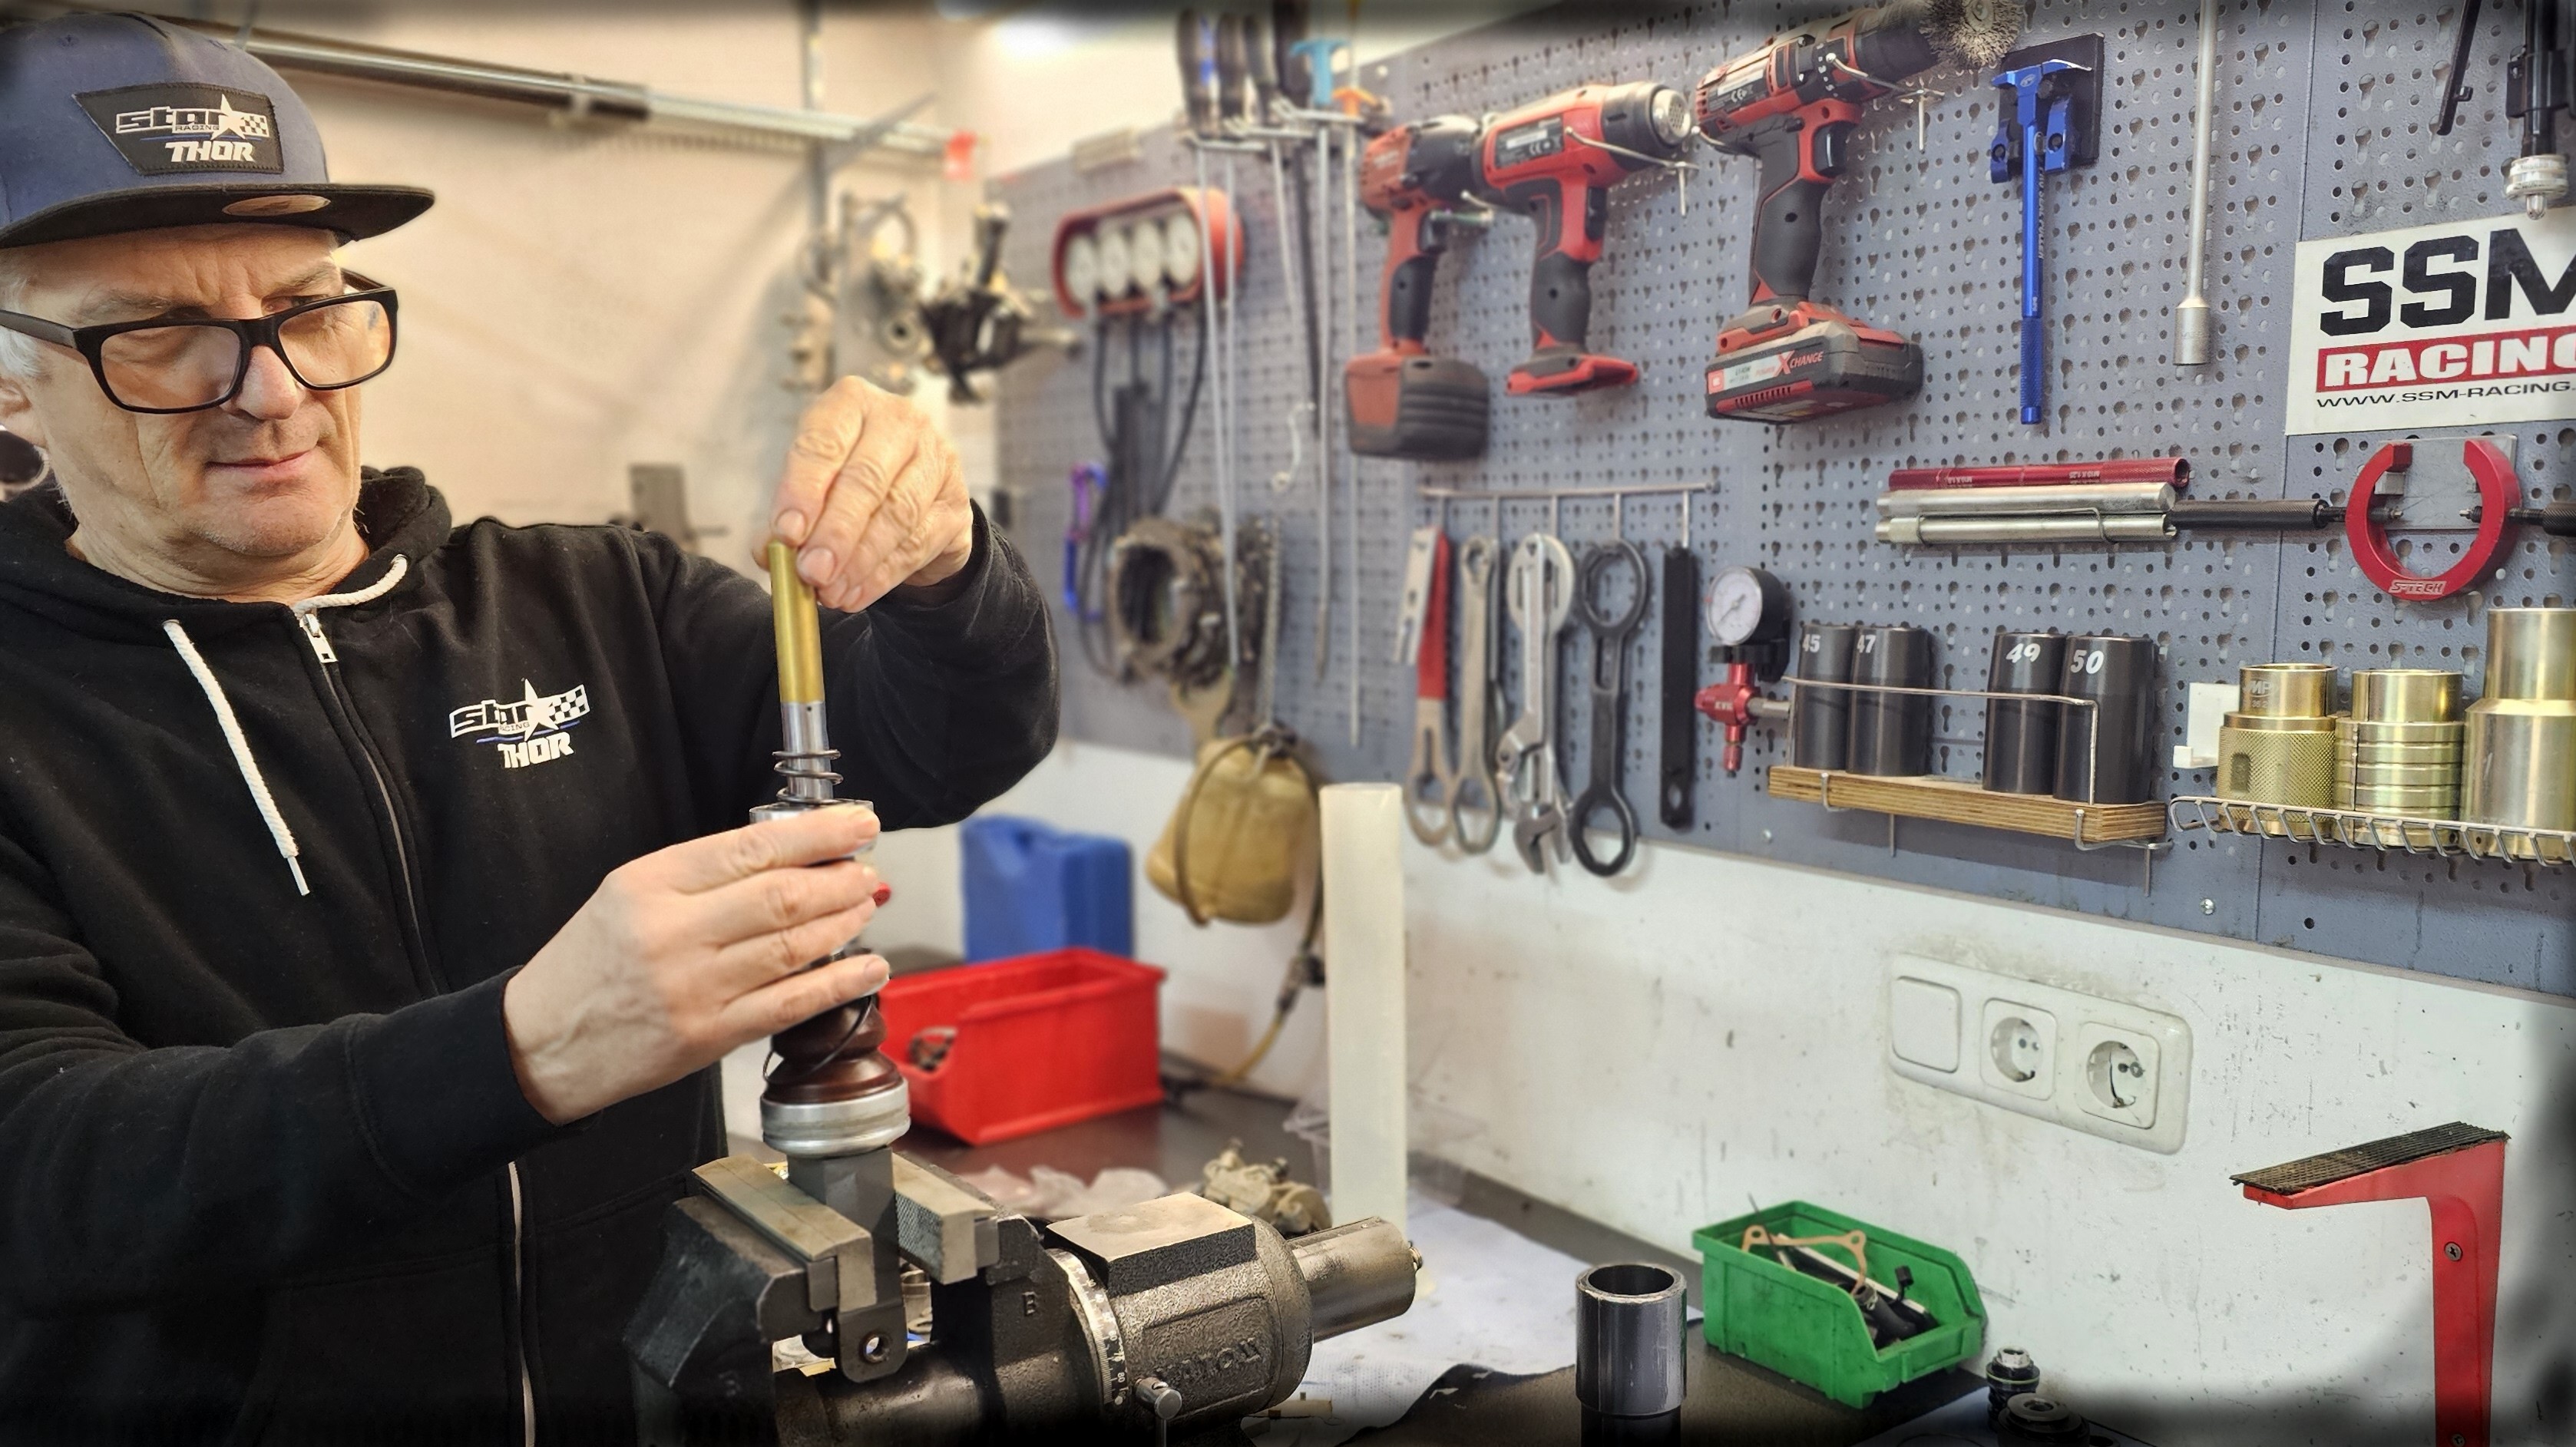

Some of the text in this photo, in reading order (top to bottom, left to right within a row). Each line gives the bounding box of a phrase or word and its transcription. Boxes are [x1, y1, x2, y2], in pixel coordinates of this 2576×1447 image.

[165, 140, 256, 163] THOR
[2320, 228, 2576, 336] SSM
[1802, 634, 1821, 652] 45
[1857, 634, 1877, 653] 47
[2006, 643, 2041, 663] 49
[2070, 649, 2105, 674] 50
[498, 732, 574, 768] THOR
